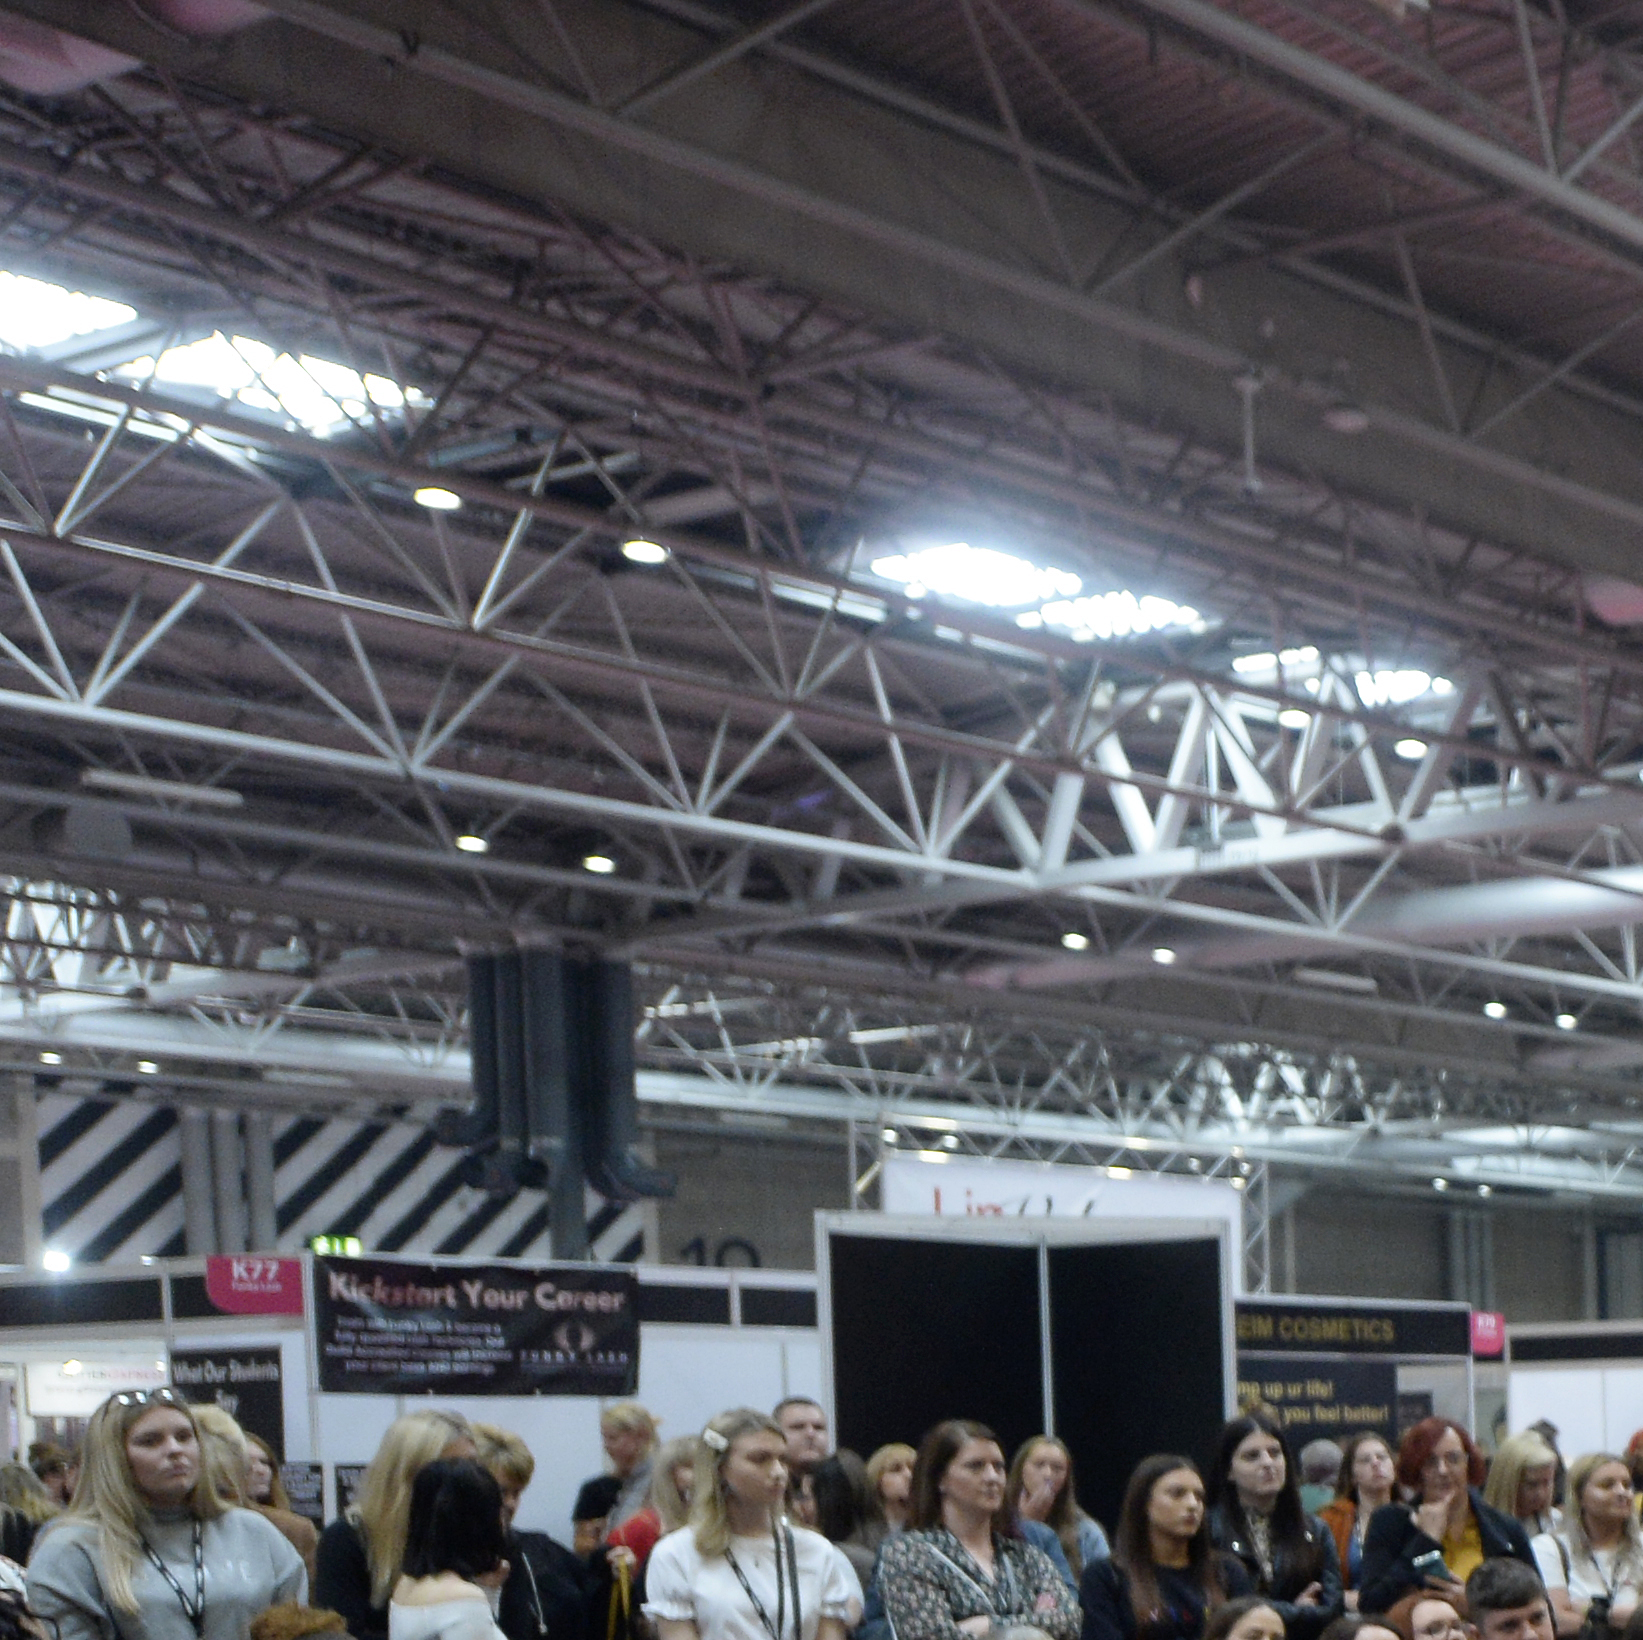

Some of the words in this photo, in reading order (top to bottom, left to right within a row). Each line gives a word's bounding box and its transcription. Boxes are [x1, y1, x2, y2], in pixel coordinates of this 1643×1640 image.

[232, 1259, 279, 1280] K77
[328, 1269, 457, 1311] Kickstart
[460, 1278, 530, 1311] Your
[534, 1280, 626, 1314] Career
[1279, 1315, 1395, 1343] COSMETICS
